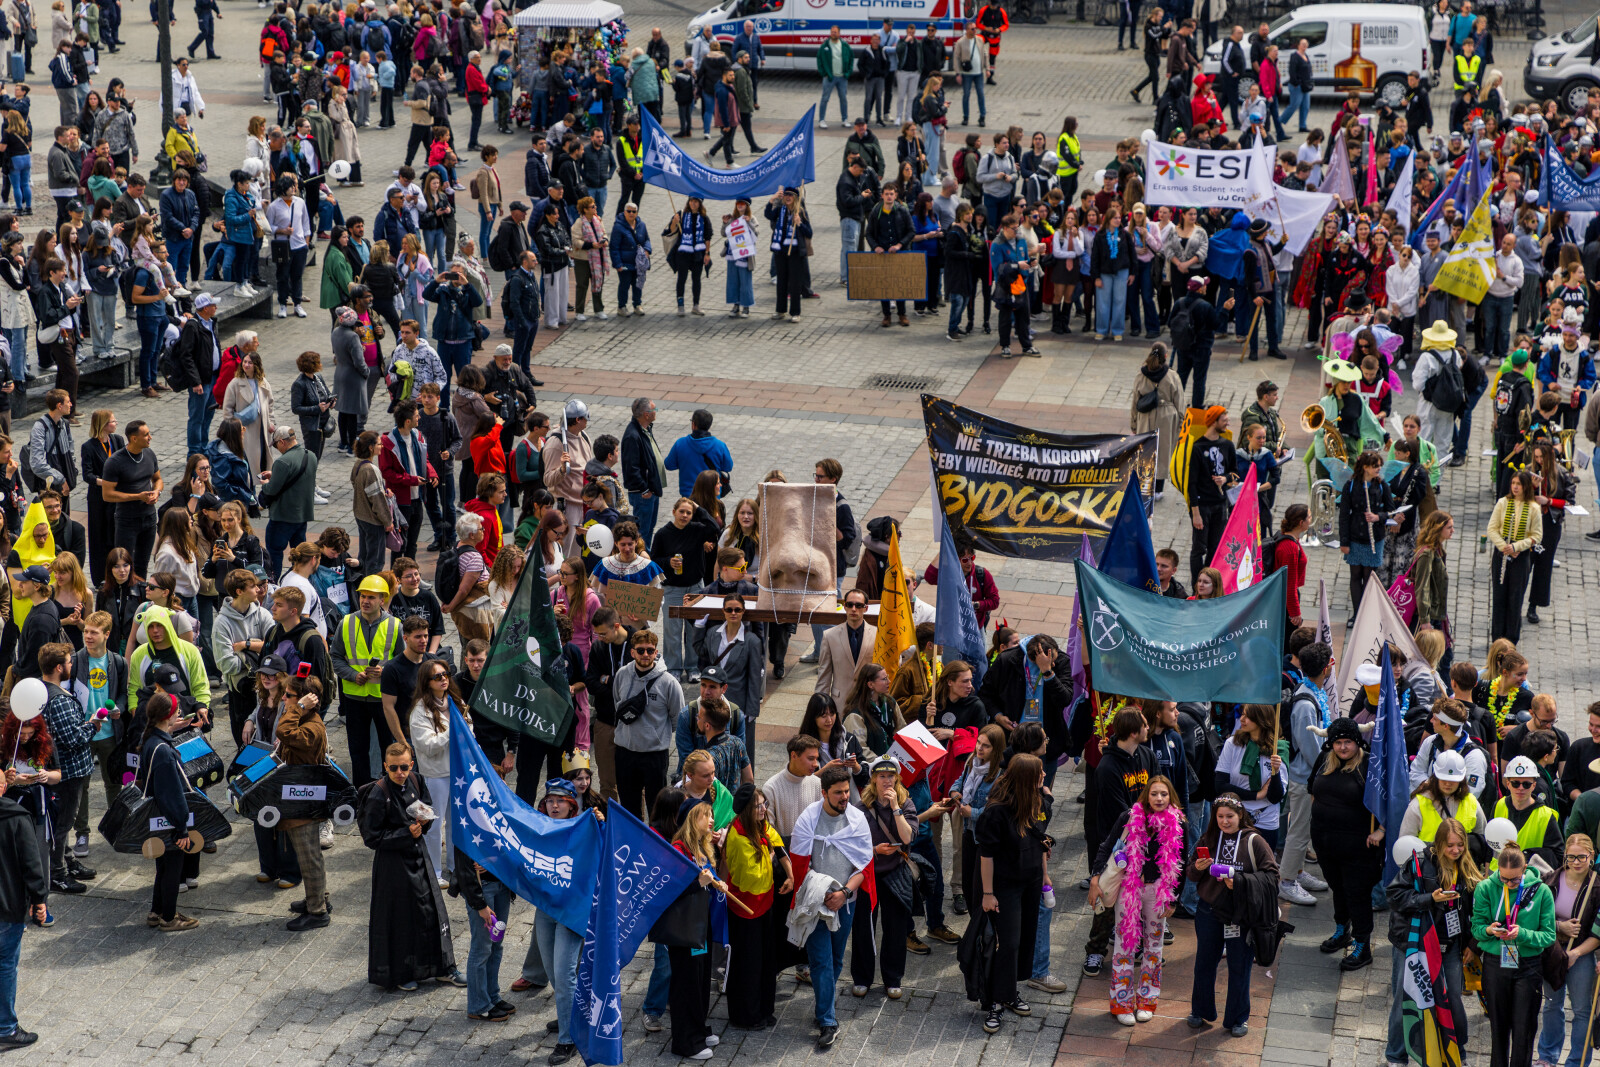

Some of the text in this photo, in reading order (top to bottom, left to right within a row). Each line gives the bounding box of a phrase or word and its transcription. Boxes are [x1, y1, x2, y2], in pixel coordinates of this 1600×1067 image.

[1363, 26, 1398, 39] BROWAR
[706, 172, 757, 184] Tadeusza
[758, 147, 804, 176] Kościuszki
[1152, 183, 1189, 192] Erasmus
[1192, 184, 1226, 193] Student
[1564, 292, 1584, 301] AGH
[955, 432, 1105, 466] NIE TRZEBA KORONY,
[965, 458, 1024, 480] WIEDZIEĆ,
[1027, 469, 1051, 483] KTO
[1053, 469, 1069, 484] TU
[1069, 466, 1123, 484] KRÓLUJE.
[939, 473, 1126, 528] BYDGOSKA
[1126, 619, 1268, 652] RADA KÓŁ NAUKOWYCH
[1128, 638, 1222, 662] UNIWERSYTETU
[1129, 645, 1238, 672] JAGIELLOŃSKIEGO
[514, 683, 538, 702] DS
[478, 688, 557, 736] NAWOJKA
[289, 787, 314, 797] Radio
[523, 862, 571, 889] KRAKÓW
